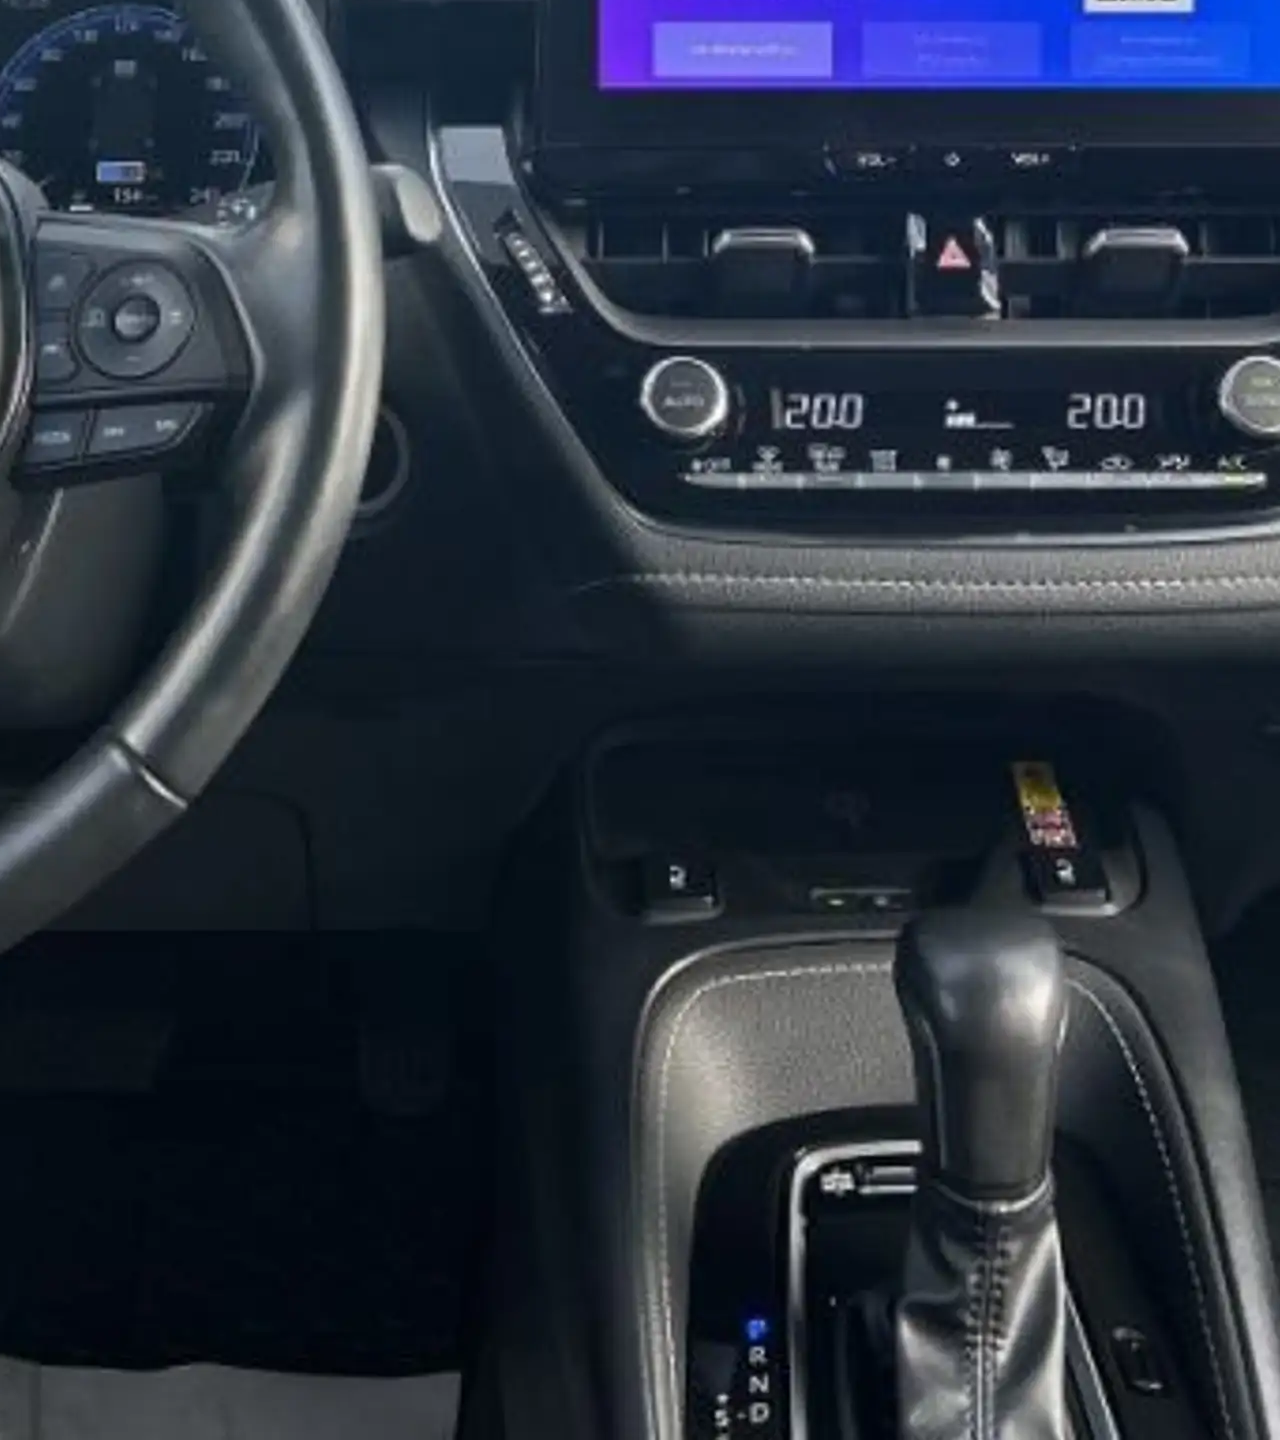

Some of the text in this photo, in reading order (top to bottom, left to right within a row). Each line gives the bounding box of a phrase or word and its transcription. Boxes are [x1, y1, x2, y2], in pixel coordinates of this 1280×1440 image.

[747, 1345, 767, 1365] R
[748, 1372, 770, 1394] N
[748, 1402, 770, 1424] D
